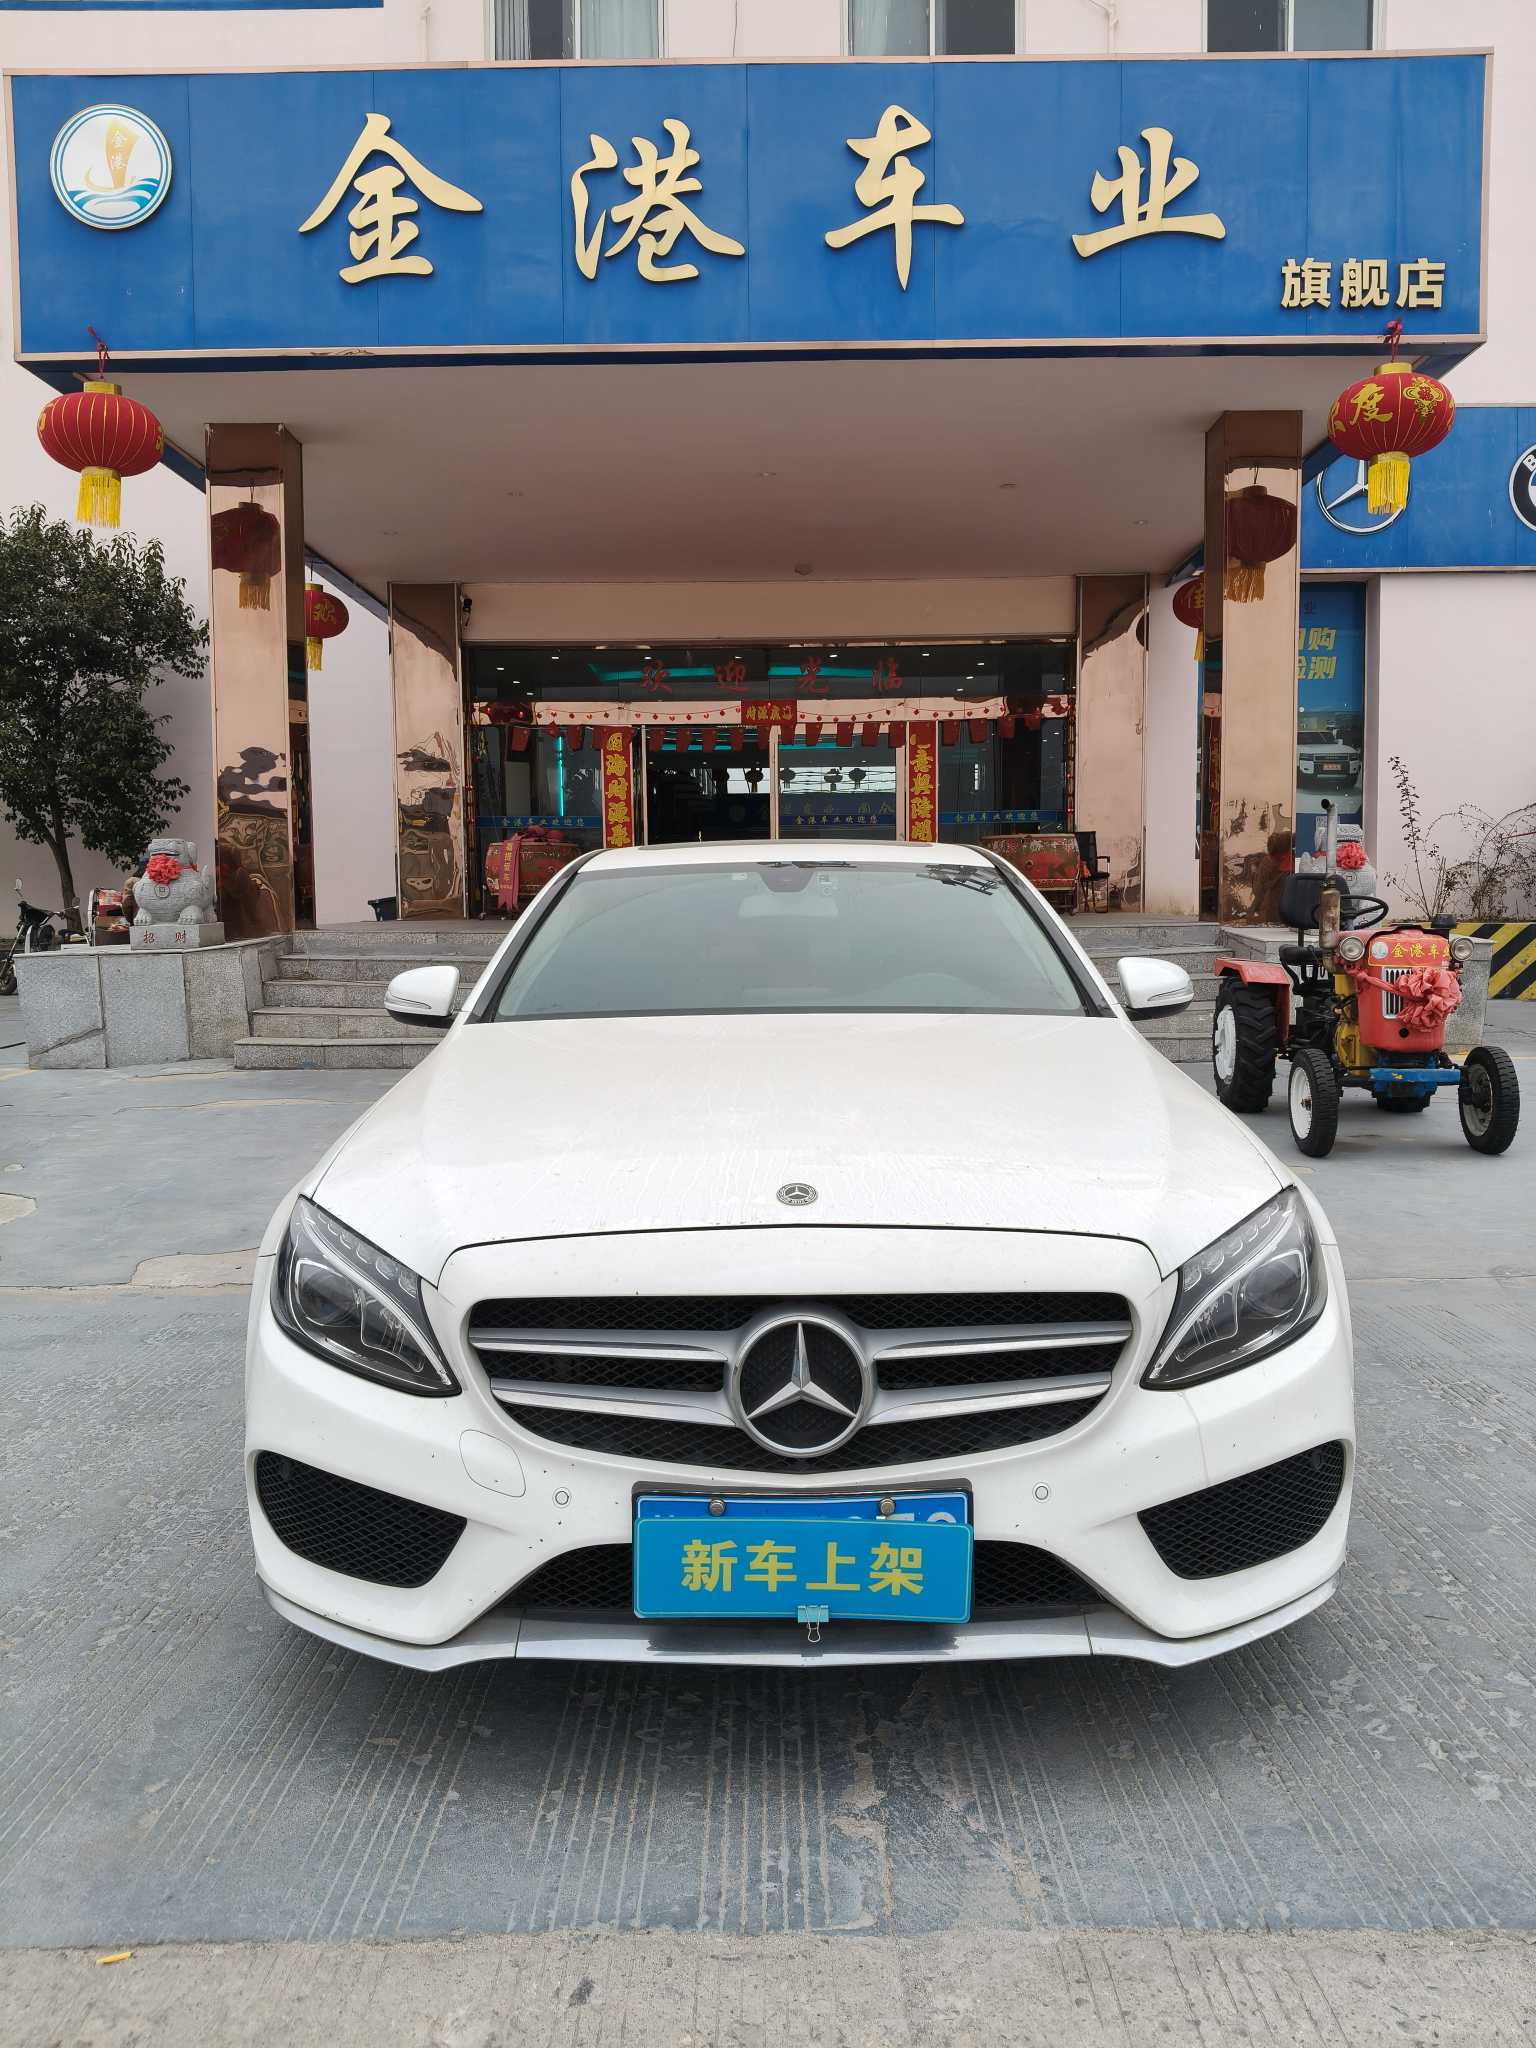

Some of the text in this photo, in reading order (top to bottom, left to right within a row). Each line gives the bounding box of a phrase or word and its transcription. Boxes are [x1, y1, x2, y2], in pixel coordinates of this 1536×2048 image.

[299, 105, 1226, 291] 金港车业
[1281, 258, 1446, 310] 旗舰店
[1350, 383, 1393, 425] 度
[640, 655, 903, 693] 欢迎光临
[143, 930, 187, 943] 招财
[681, 1539, 923, 1596] 新车上架
